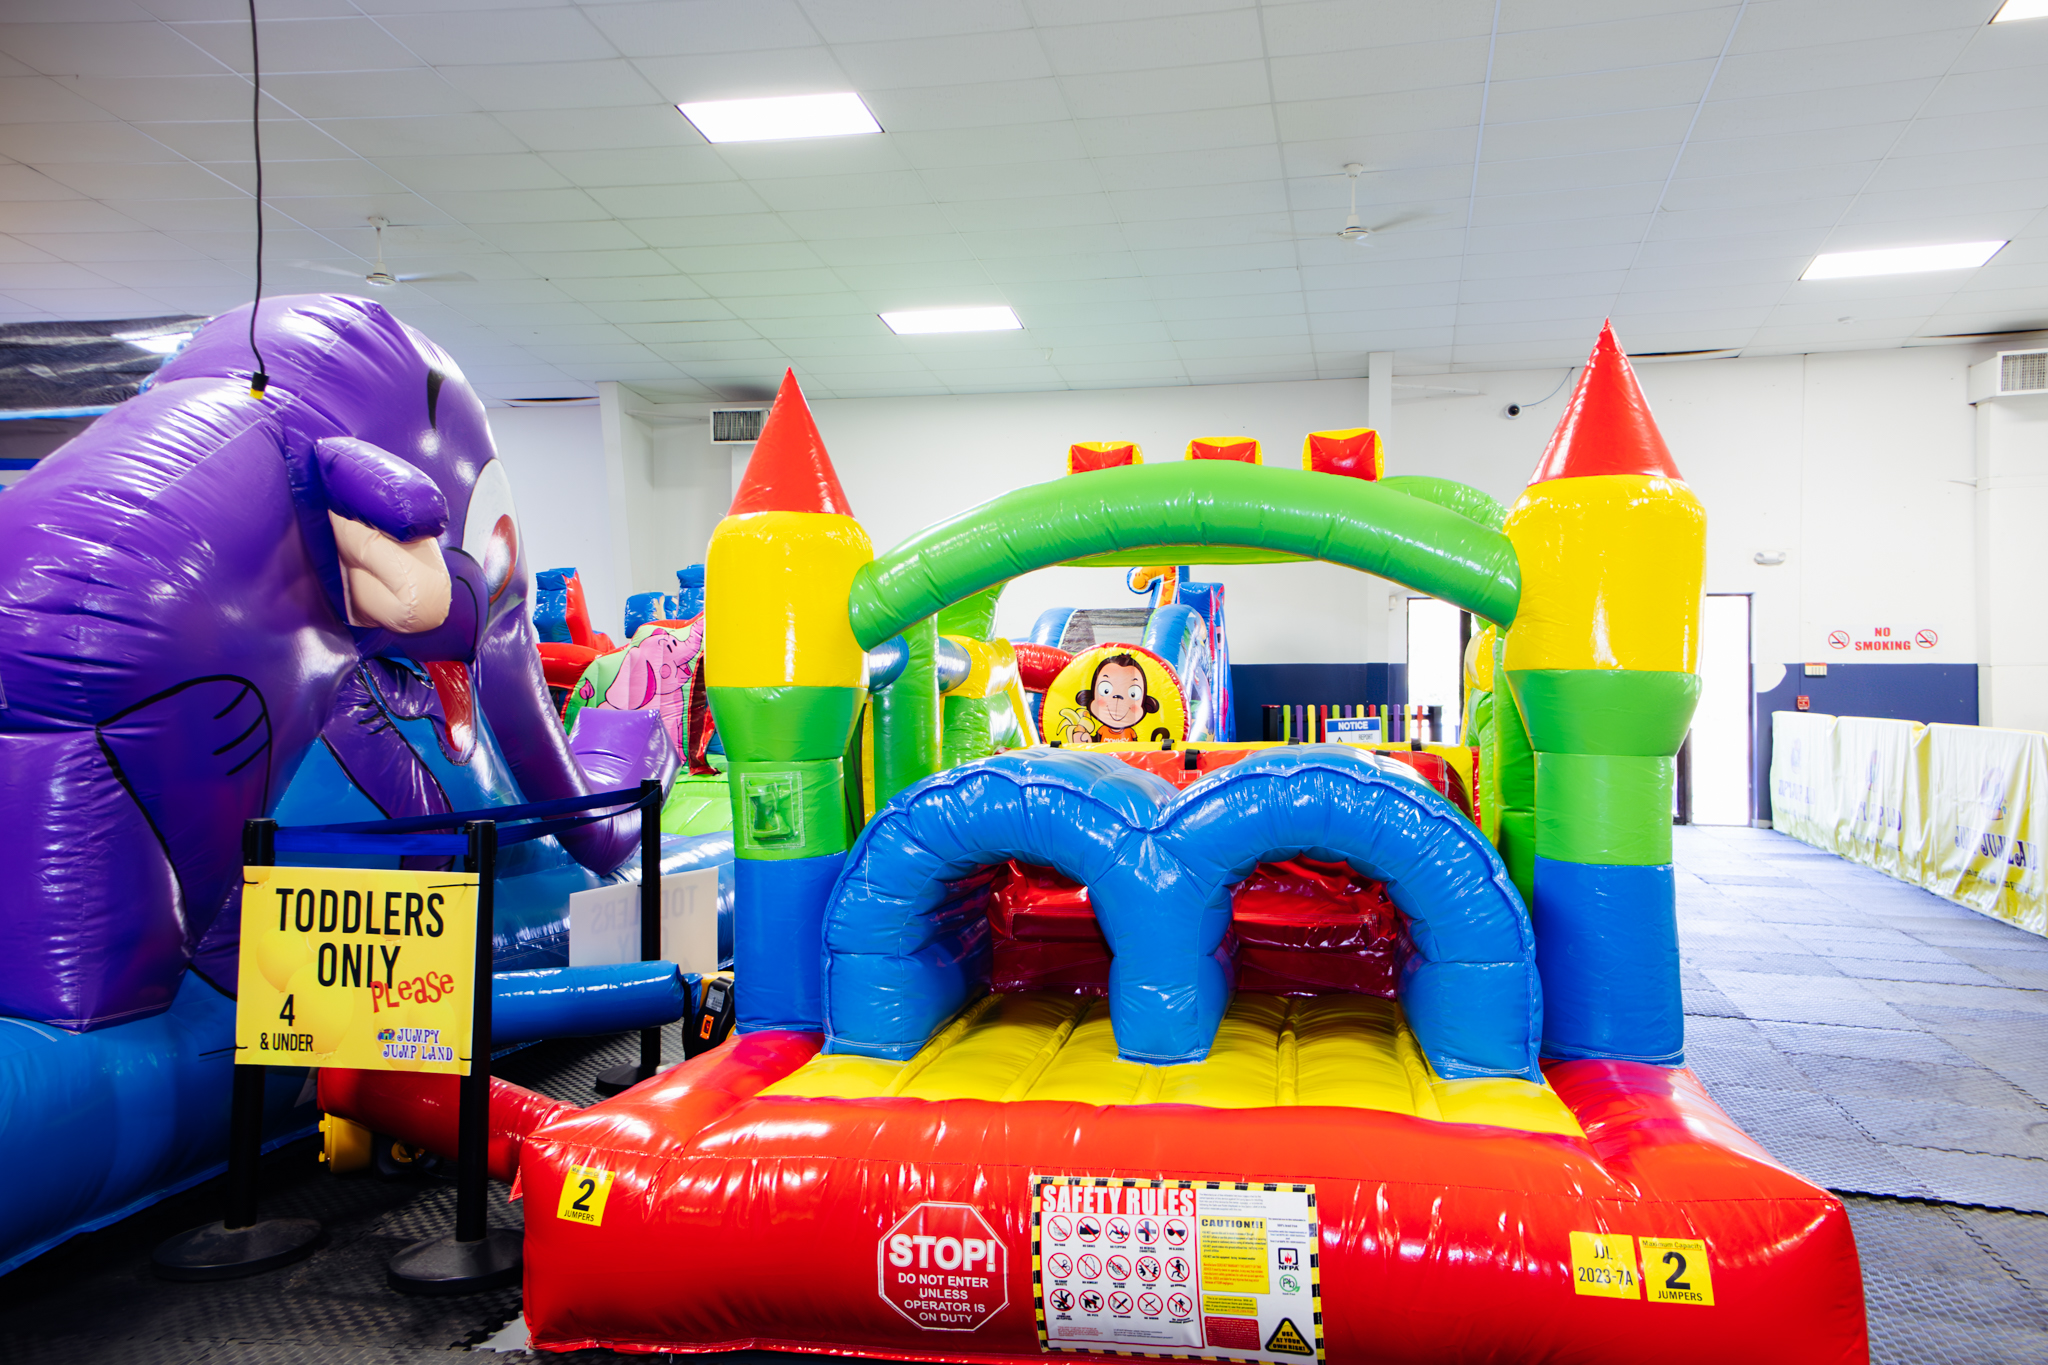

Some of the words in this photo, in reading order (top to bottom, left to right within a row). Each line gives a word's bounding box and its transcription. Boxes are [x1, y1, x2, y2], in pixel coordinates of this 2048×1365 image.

[1874, 627, 1891, 637] NO
[1855, 640, 1911, 651] SMOKING
[1338, 721, 1369, 731] NOTICE
[276, 888, 445, 938] TODDLERS
[317, 942, 401, 989] ONLY
[279, 994, 295, 1026] 4
[260, 1032, 270, 1050] &
[273, 1033, 314, 1052] UNDER
[396, 1028, 440, 1044] JUMPY
[383, 1044, 417, 1059] JUMP
[421, 1045, 453, 1061] LAND
[572, 1178, 595, 1212] 2
[1042, 1185, 1127, 1214] SAFETY
[1127, 1188, 1194, 1216] RULES
[564, 1209, 594, 1222] JUMPERS
[1201, 1218, 1263, 1229] CAUTION!!!
[889, 1233, 996, 1272] STOP!
[1642, 1240, 1674, 1248] Maximum
[1674, 1241, 1703, 1251] Capacity
[1578, 1266, 1634, 1286] 2023-7A
[1662, 1251, 1691, 1290] 2
[898, 1272, 916, 1284] DO
[919, 1274, 944, 1285] NOT
[948, 1276, 989, 1288] ENTER
[919, 1288, 968, 1299] UNLESS
[1658, 1290, 1703, 1301] JUMPERS
[904, 1299, 971, 1312] OPERATOR
[974, 1303, 986, 1313] IS
[919, 1312, 937, 1321] ON
[940, 1313, 972, 1323] DUTY
